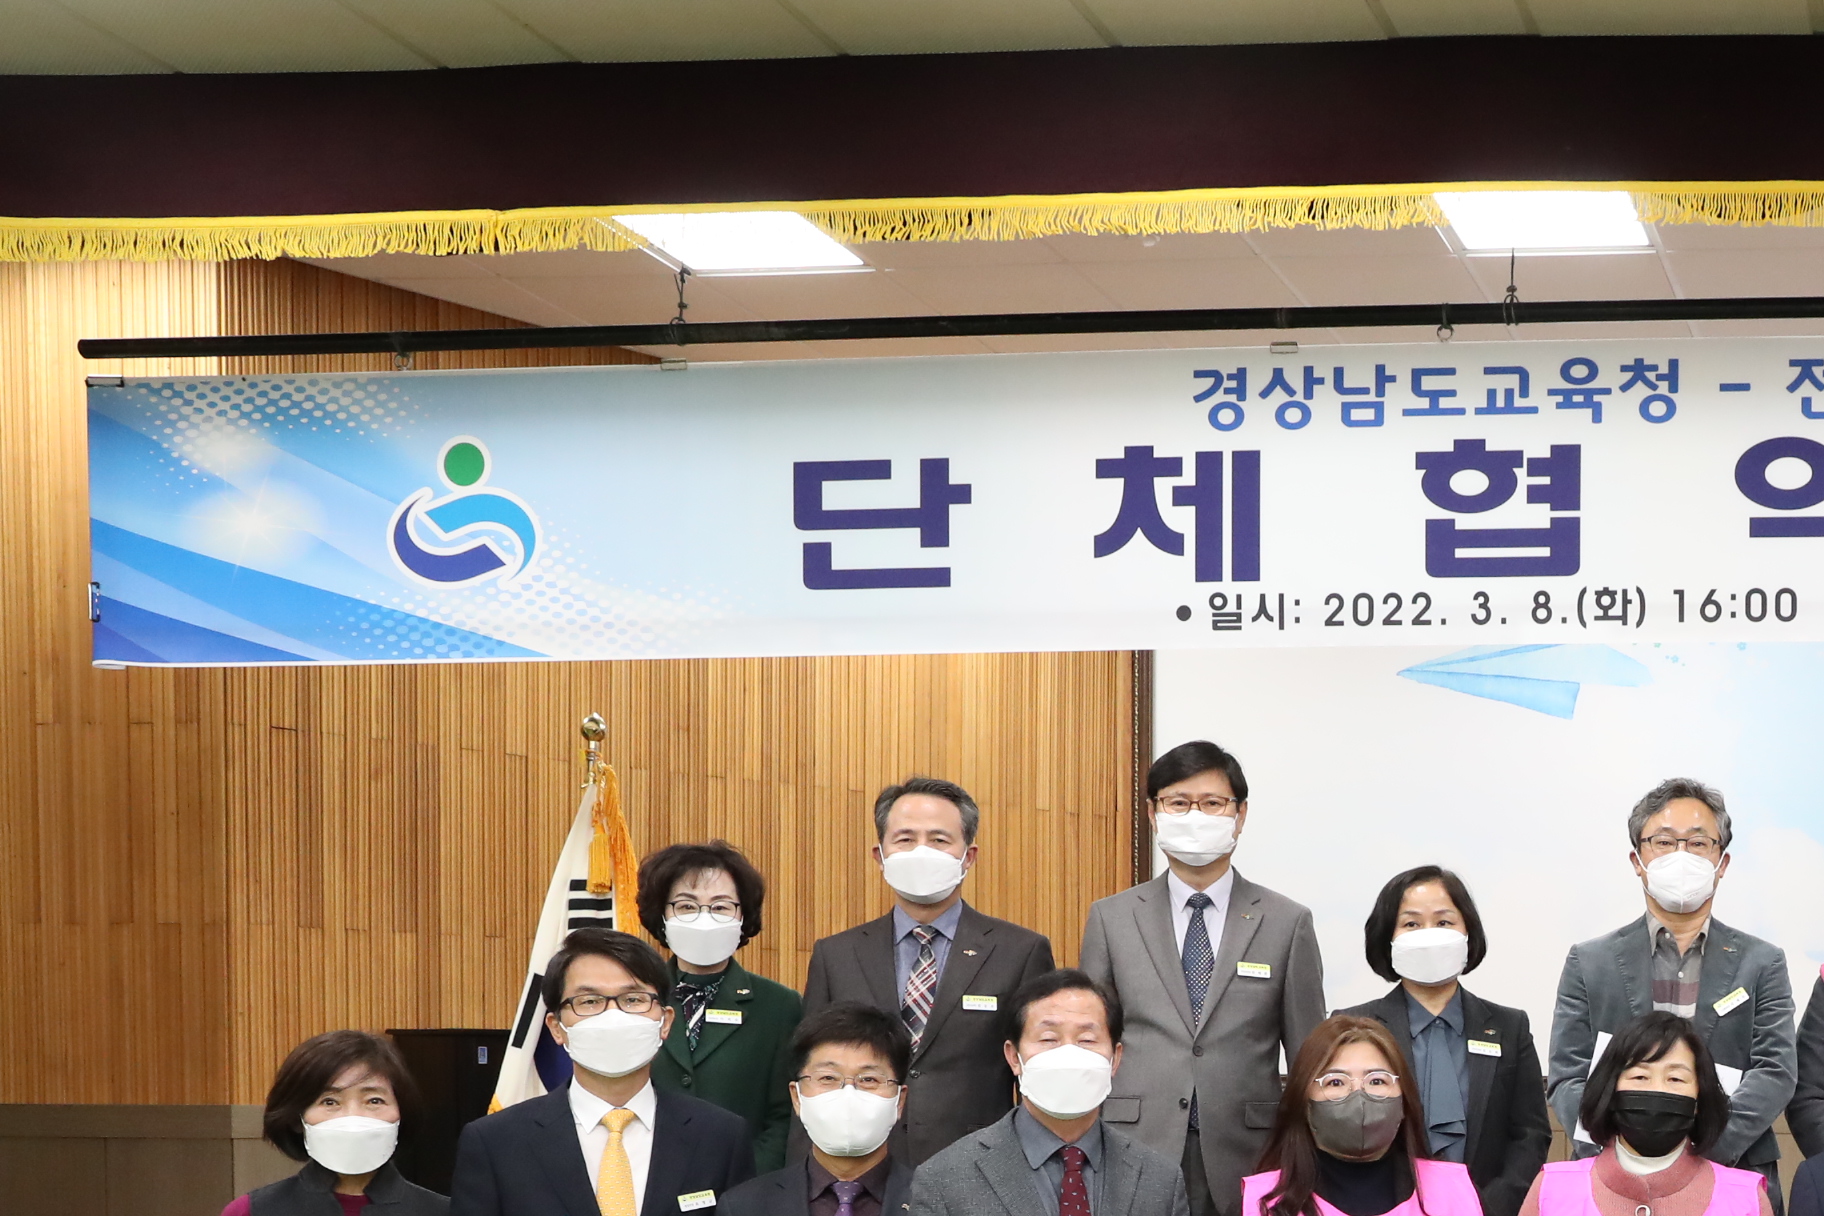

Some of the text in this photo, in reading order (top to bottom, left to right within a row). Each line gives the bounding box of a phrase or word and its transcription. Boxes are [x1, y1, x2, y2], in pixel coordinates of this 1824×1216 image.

[1192, 356, 1680, 432] 경상남도교육청
[793, 457, 972, 590] 단
[1093, 445, 1261, 583] 체
[1415, 438, 1582, 578] 협
[1208, 592, 1300, 631] 일시:
[1324, 591, 1448, 627] 2022.
[1470, 591, 1507, 626] 3.
[1673, 587, 1798, 624] 16:00
